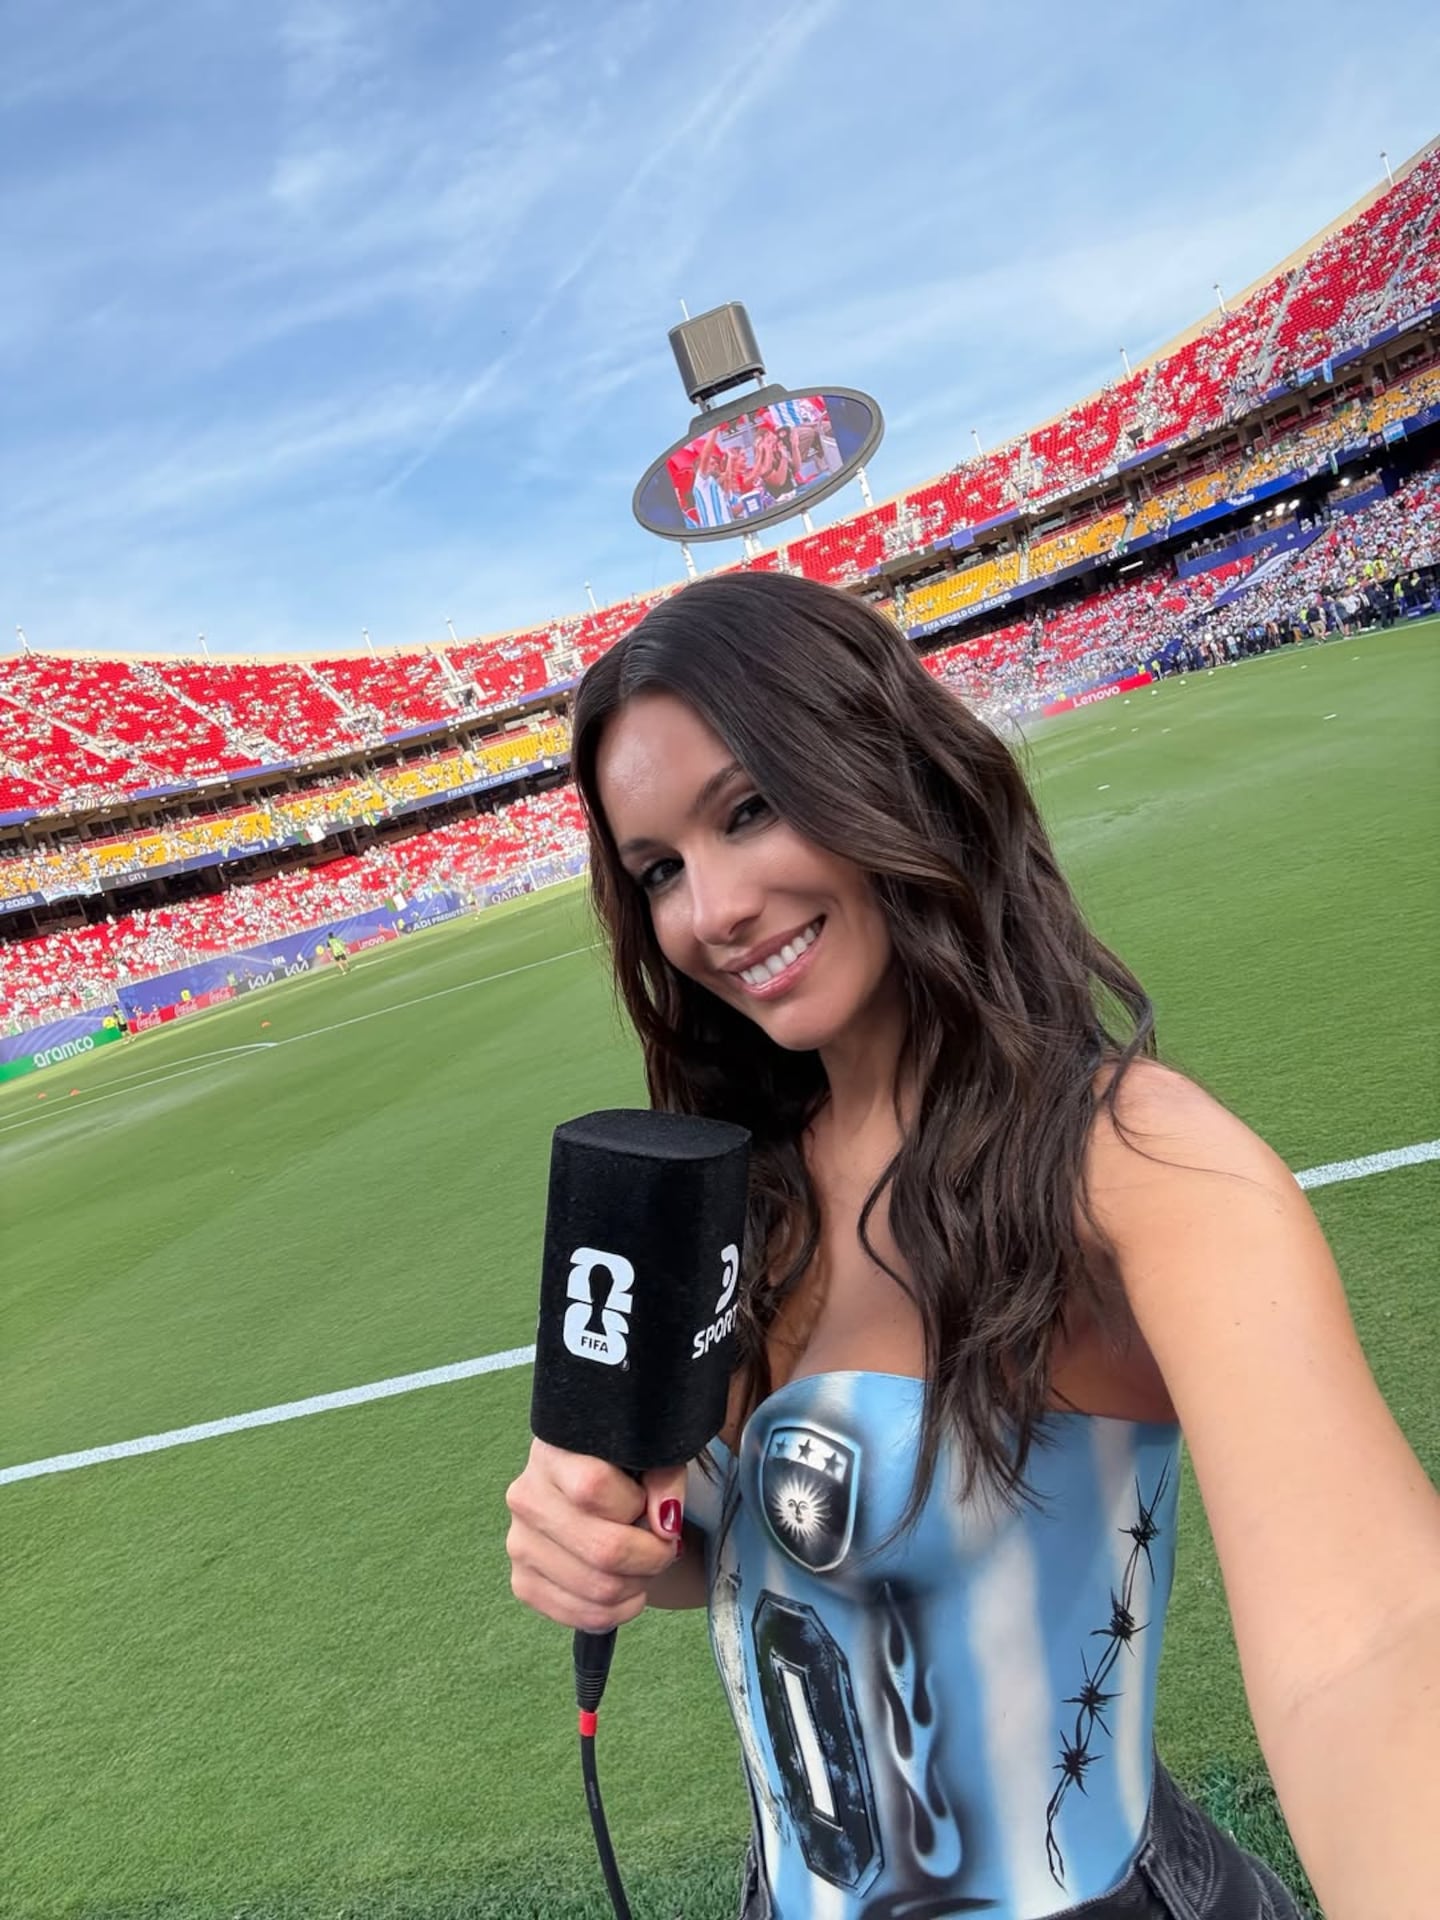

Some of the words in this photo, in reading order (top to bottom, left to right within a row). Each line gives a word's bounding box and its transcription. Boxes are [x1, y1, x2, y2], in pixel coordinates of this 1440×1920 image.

[922, 621, 940, 632] FIFA
[940, 610, 967, 625] WORLD
[967, 604, 983, 614] CUP
[983, 592, 1012, 608] 2026
[1072, 685, 1120, 708] Lenovo
[5, 895, 35, 909] 2026
[490, 887, 527, 904] QATAR
[32, 1035, 95, 1069] aramco
[580, 1336, 609, 1353] FIFA
